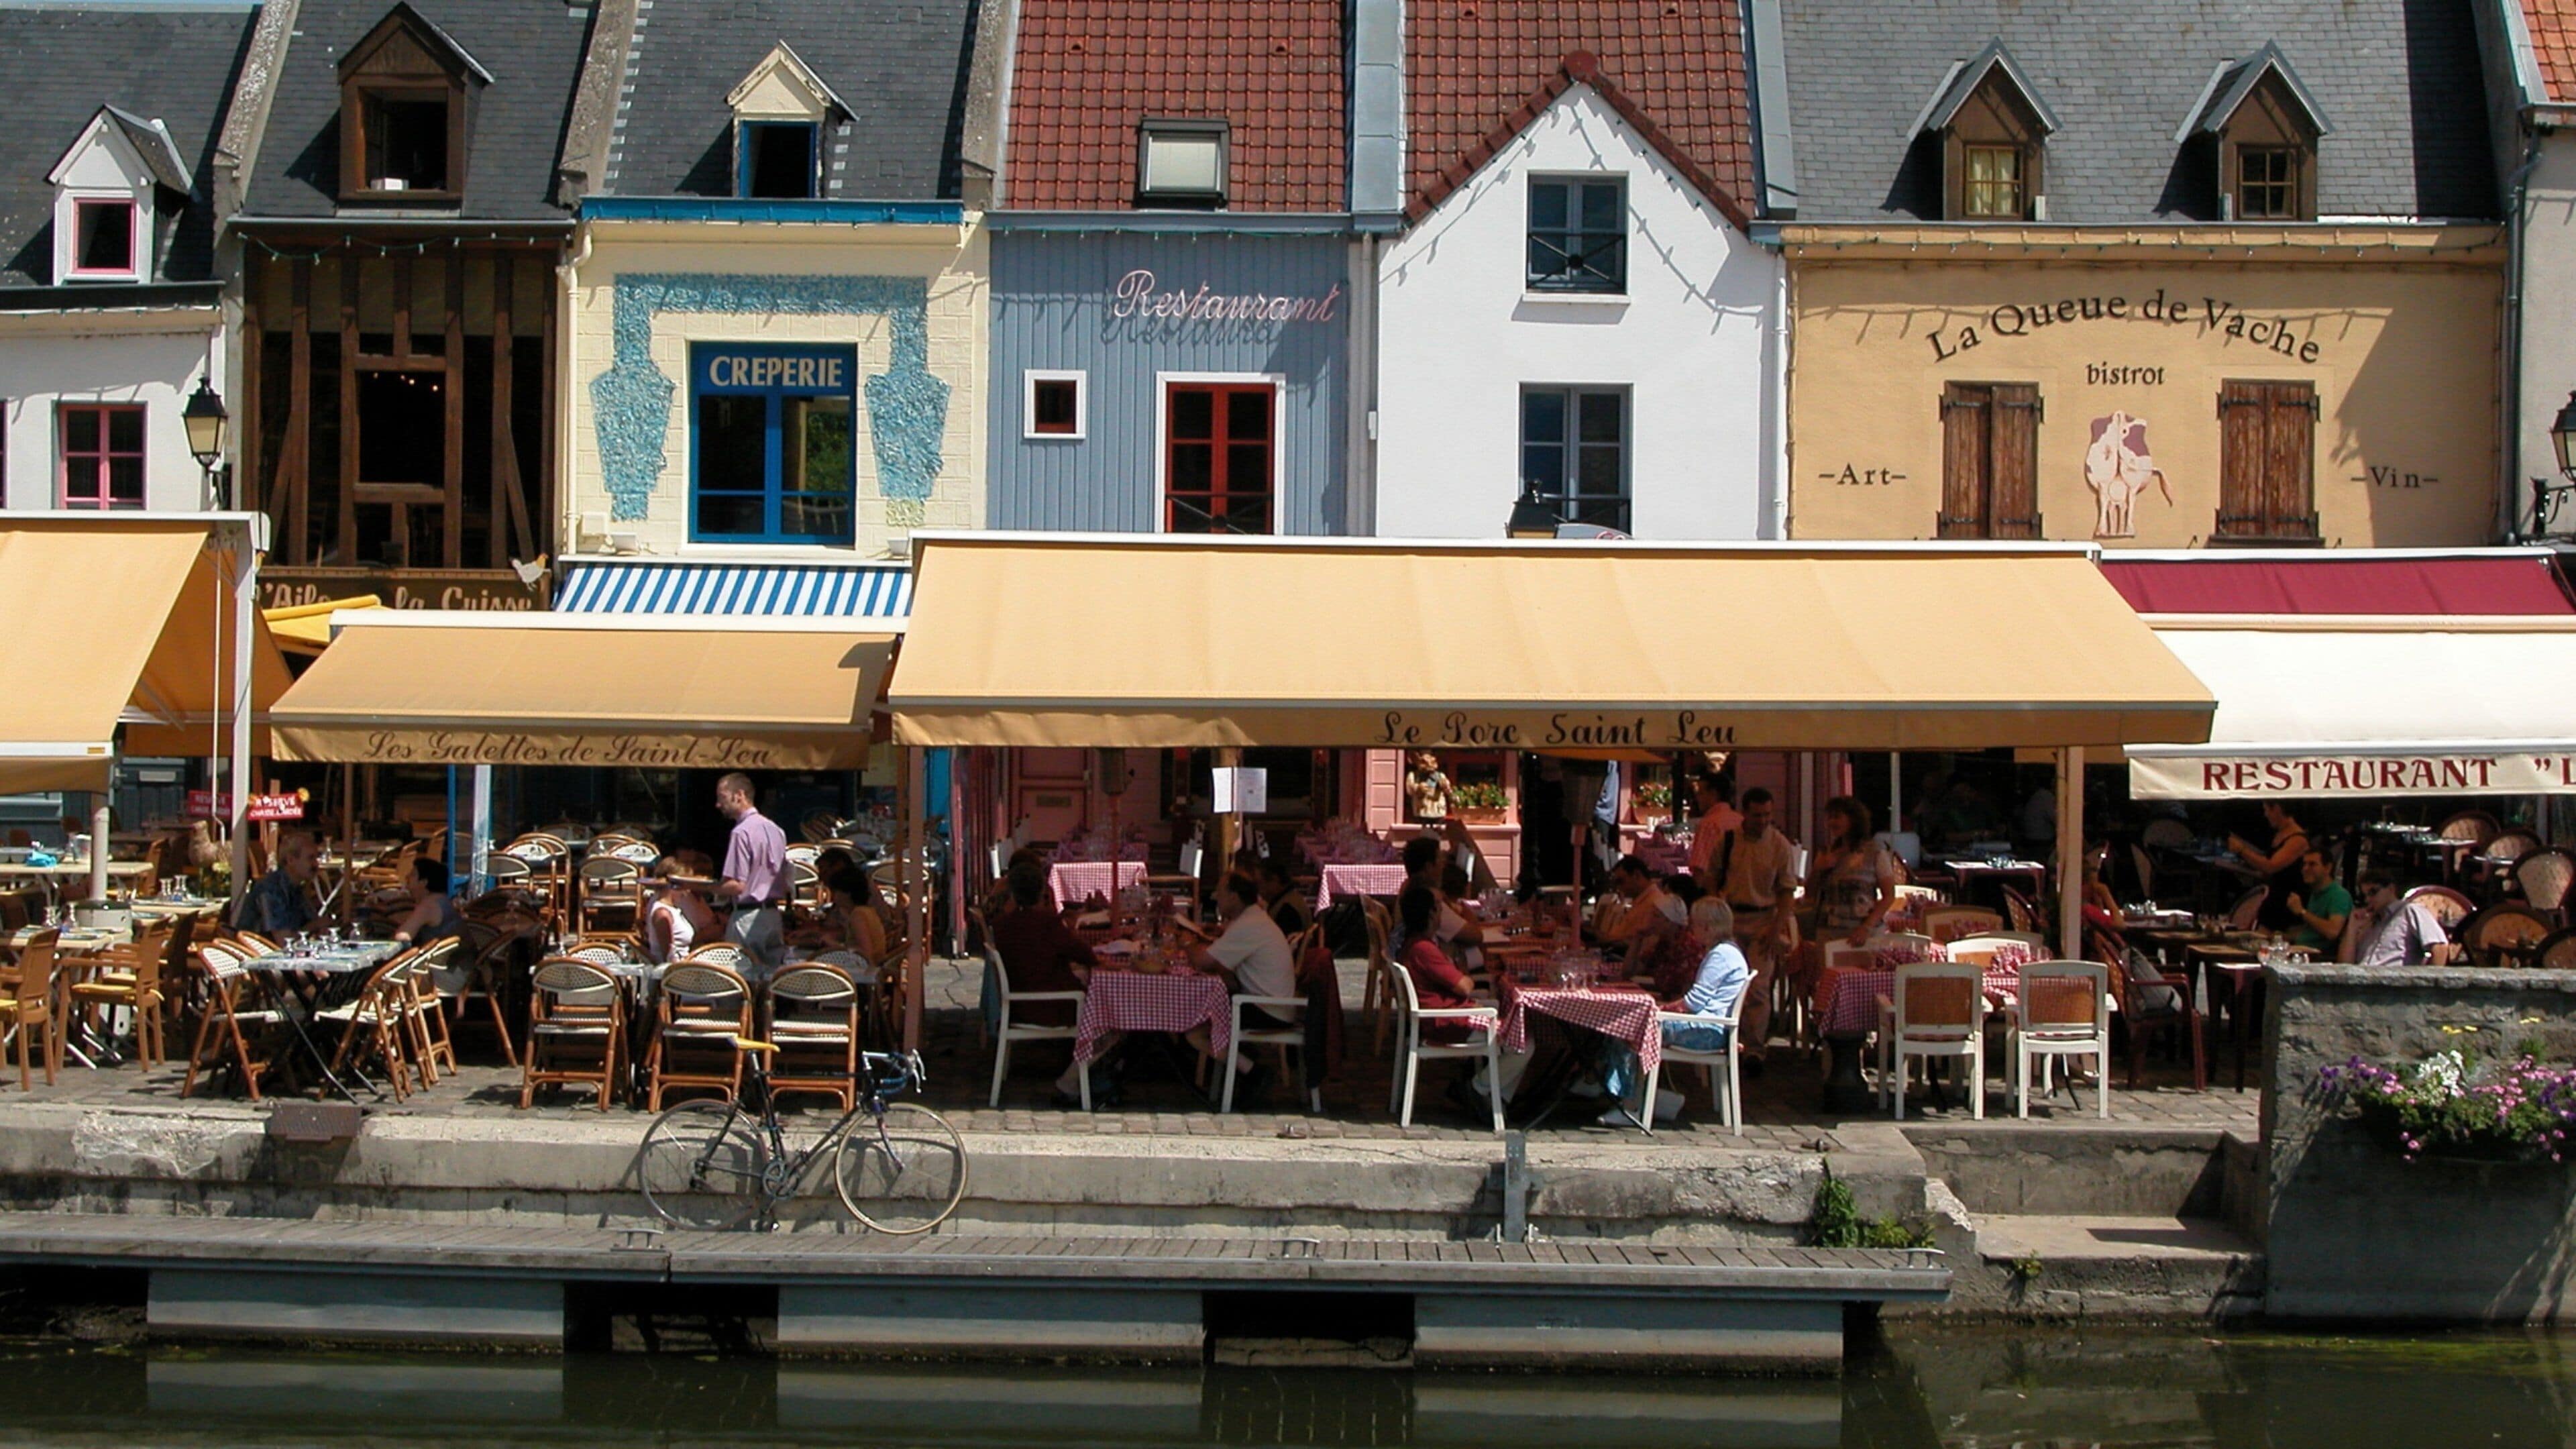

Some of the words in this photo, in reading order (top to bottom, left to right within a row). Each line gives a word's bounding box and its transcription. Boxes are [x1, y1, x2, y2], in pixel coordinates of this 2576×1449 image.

[1114, 269, 1341, 322] Restaurant
[1926, 325, 1982, 364] La
[1990, 296, 2128, 337] Queue
[2143, 288, 2189, 323] de
[2202, 297, 2320, 364] Vache
[709, 355, 843, 387] CREPERIE
[2086, 361, 2165, 385] bistrot
[395, 586, 425, 610] la
[1375, 710, 1421, 744] Le
[1442, 711, 1520, 745] Porc
[1545, 713, 1646, 745] Saint
[1667, 710, 1737, 745] Leu
[363, 731, 413, 759] Les
[427, 733, 549, 761] Galettes
[558, 735, 594, 761] de
[604, 735, 770, 764] Saint-Leu
[2203, 757, 2498, 792] RESTAURANT
